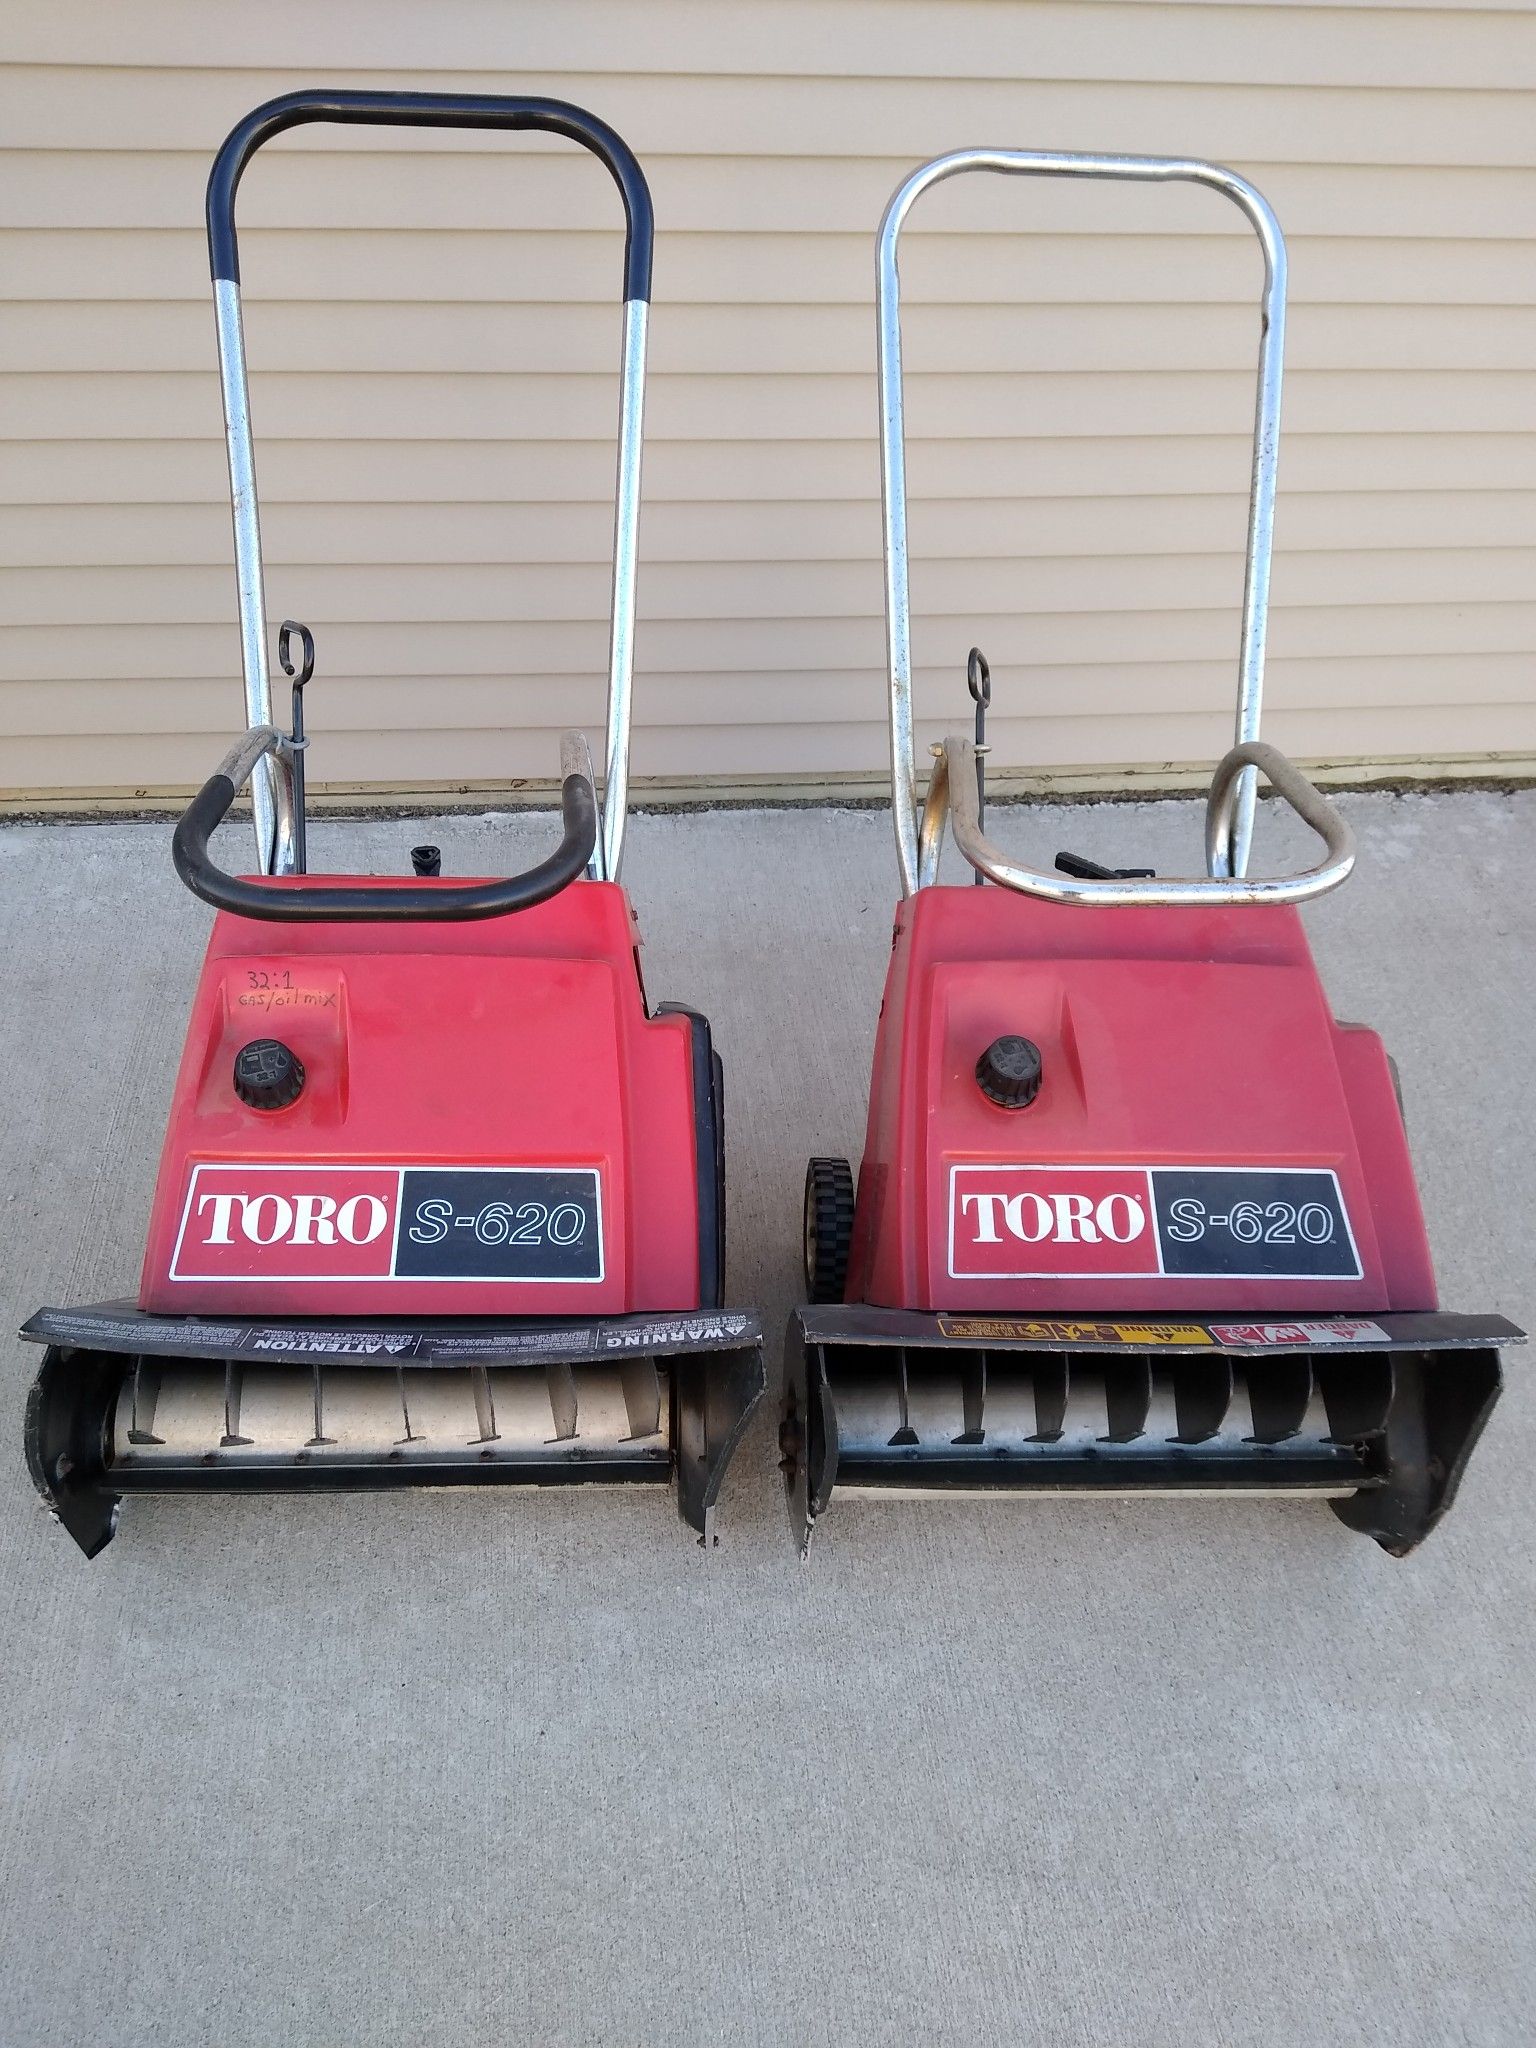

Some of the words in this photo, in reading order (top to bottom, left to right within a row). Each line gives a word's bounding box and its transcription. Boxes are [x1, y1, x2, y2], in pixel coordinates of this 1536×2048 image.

[247, 970, 294, 990] 32:1
[304, 991, 337, 1007] mix
[198, 1194, 388, 1245] TORO
[408, 1199, 585, 1245] S-620
[961, 1193, 1145, 1243] TORO
[1167, 1198, 1334, 1244] S-620
[253, 1340, 383, 1353] ATTENTION
[606, 1328, 724, 1347] WARNING
